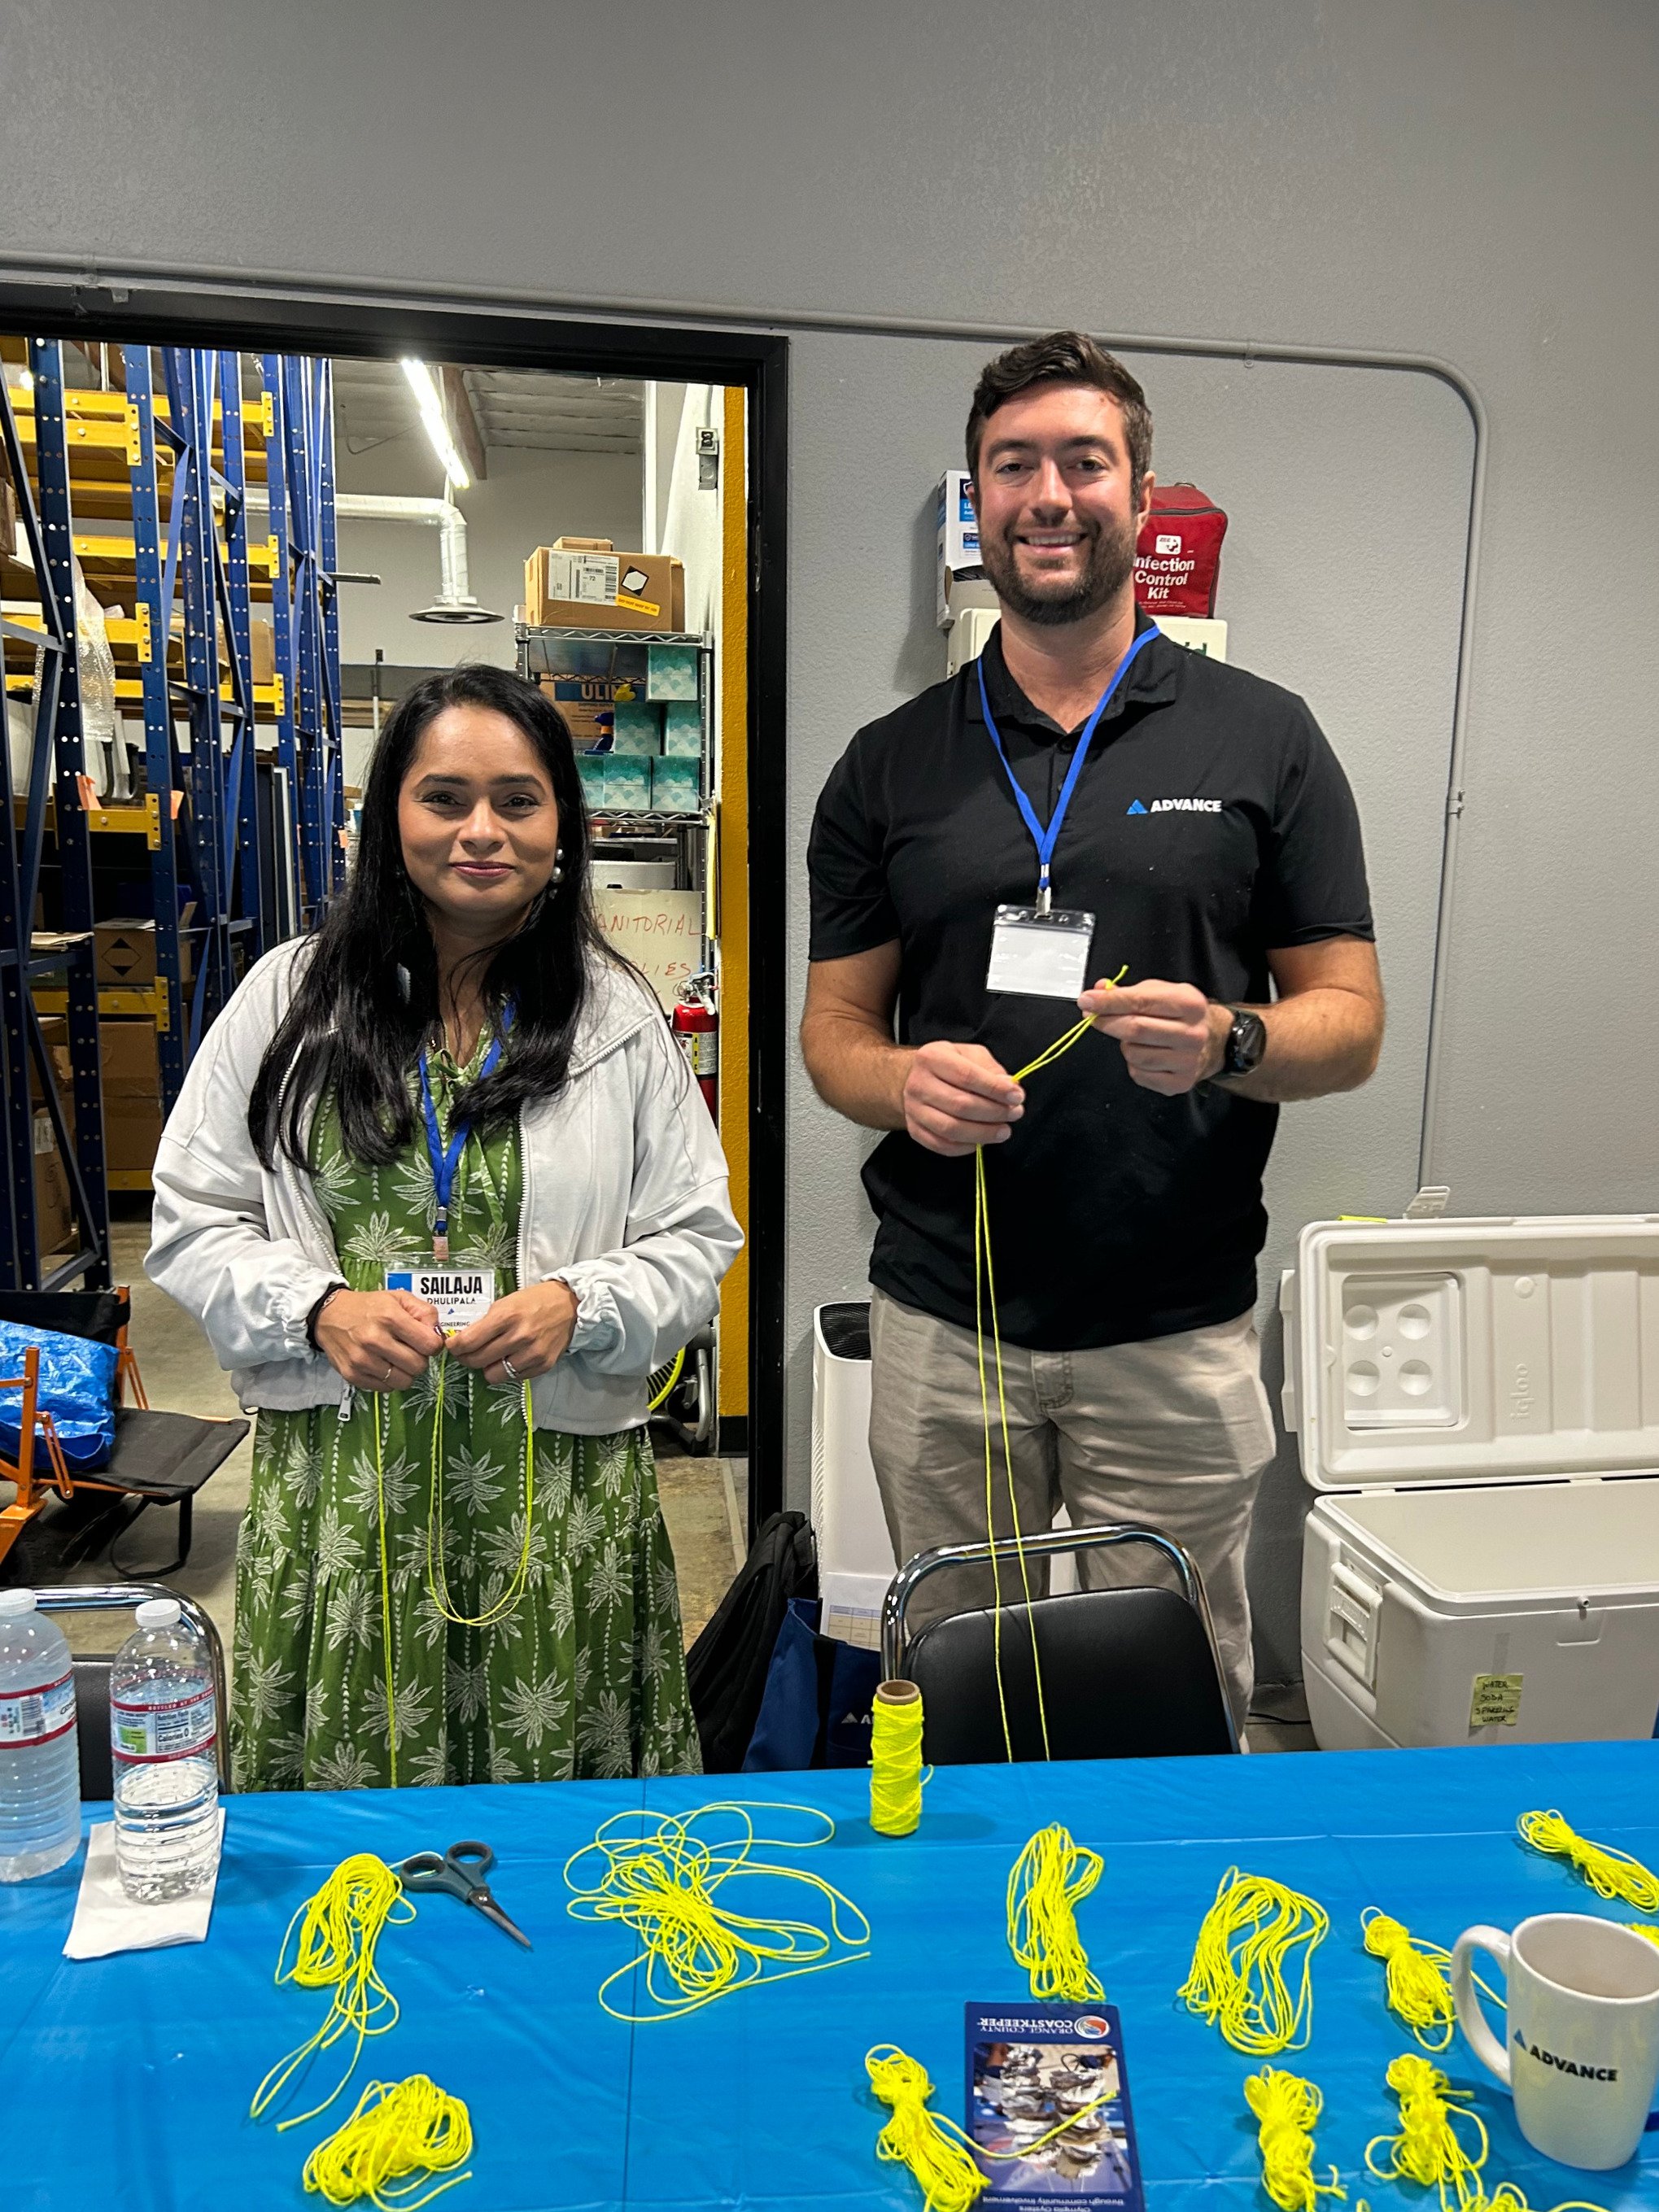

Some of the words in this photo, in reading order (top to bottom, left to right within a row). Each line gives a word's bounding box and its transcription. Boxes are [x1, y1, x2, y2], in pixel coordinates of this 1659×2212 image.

[1134, 570, 1189, 587] Control
[1147, 587, 1170, 600] Kit
[1150, 798, 1222, 813] ADVANCE
[596, 913, 702, 936] ANITORIAL
[420, 1276, 482, 1294] SAILAJA
[426, 1297, 477, 1305] DHULIPALA
[1480, 1693, 1504, 1702] SODA
[980, 2018, 1073, 2028] COASTKEEPER
[1030, 2027, 1074, 2035] ORANGE
[1529, 2044, 1618, 2082] ADVANCE
[1037, 2196, 1088, 2205] community
[1089, 2197, 1124, 2206] through
